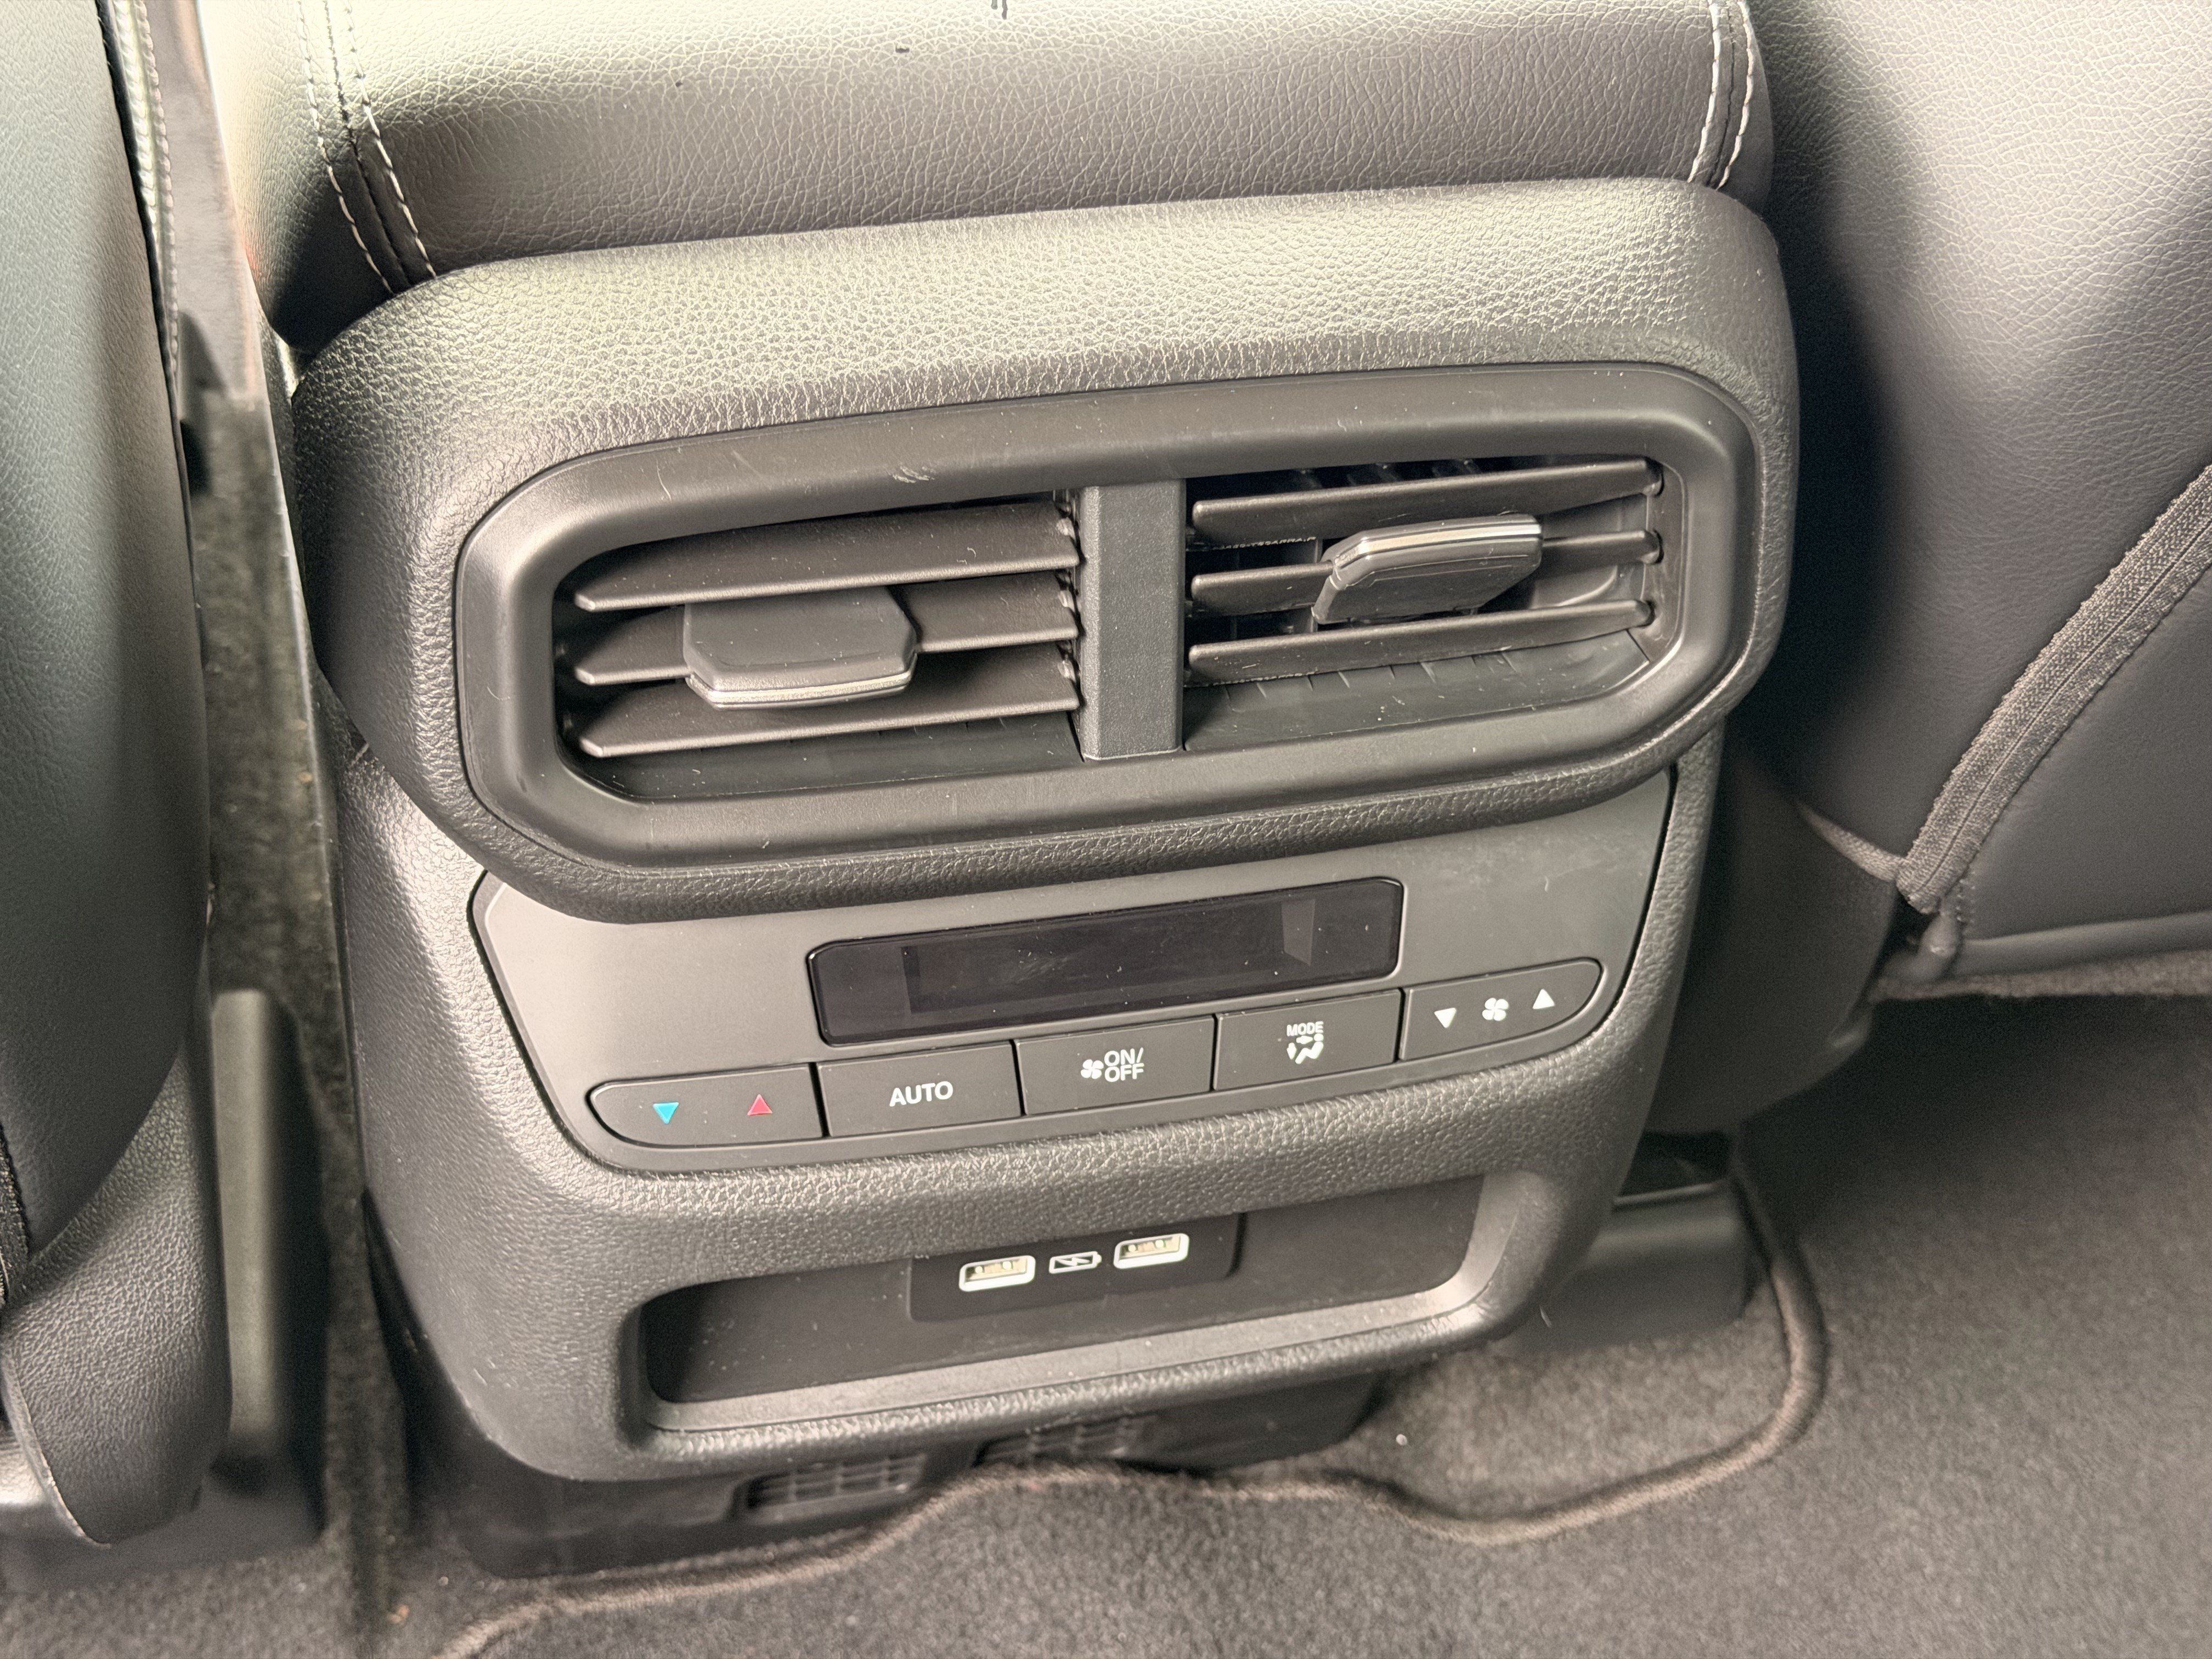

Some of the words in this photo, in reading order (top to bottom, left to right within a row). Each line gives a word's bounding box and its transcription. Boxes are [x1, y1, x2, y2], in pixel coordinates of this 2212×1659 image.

[1286, 1020, 1324, 1037] MODE
[1104, 1047, 1144, 1066] ON/
[1104, 1063, 1145, 1082] OFF
[889, 1080, 953, 1107] AUTO
